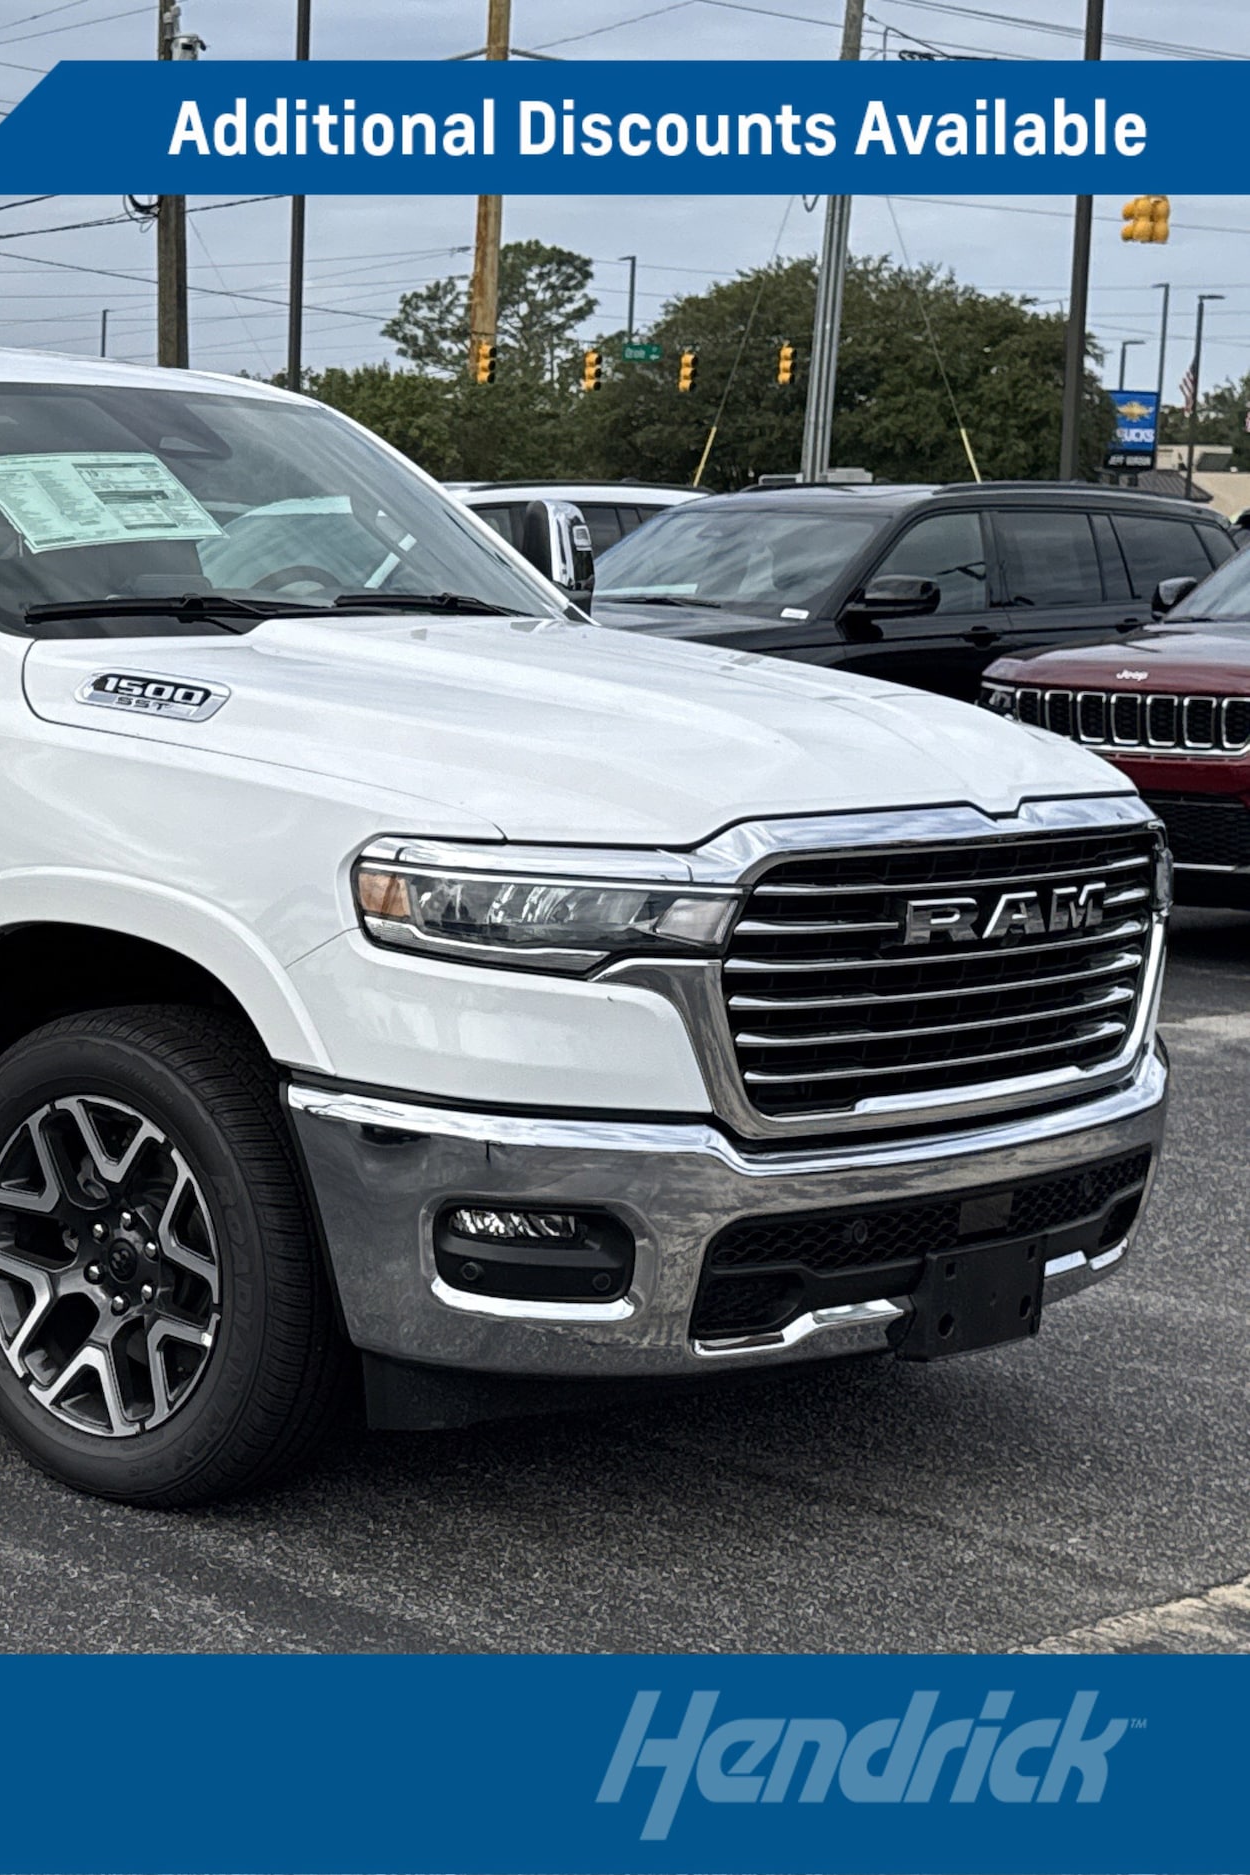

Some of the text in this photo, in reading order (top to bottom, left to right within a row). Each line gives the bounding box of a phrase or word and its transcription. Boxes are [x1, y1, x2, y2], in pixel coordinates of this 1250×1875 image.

[1116, 428, 1155, 443] UCKS
[1116, 669, 1148, 682] Jeep
[104, 677, 204, 705] 1500
[903, 882, 1106, 945] RAM
